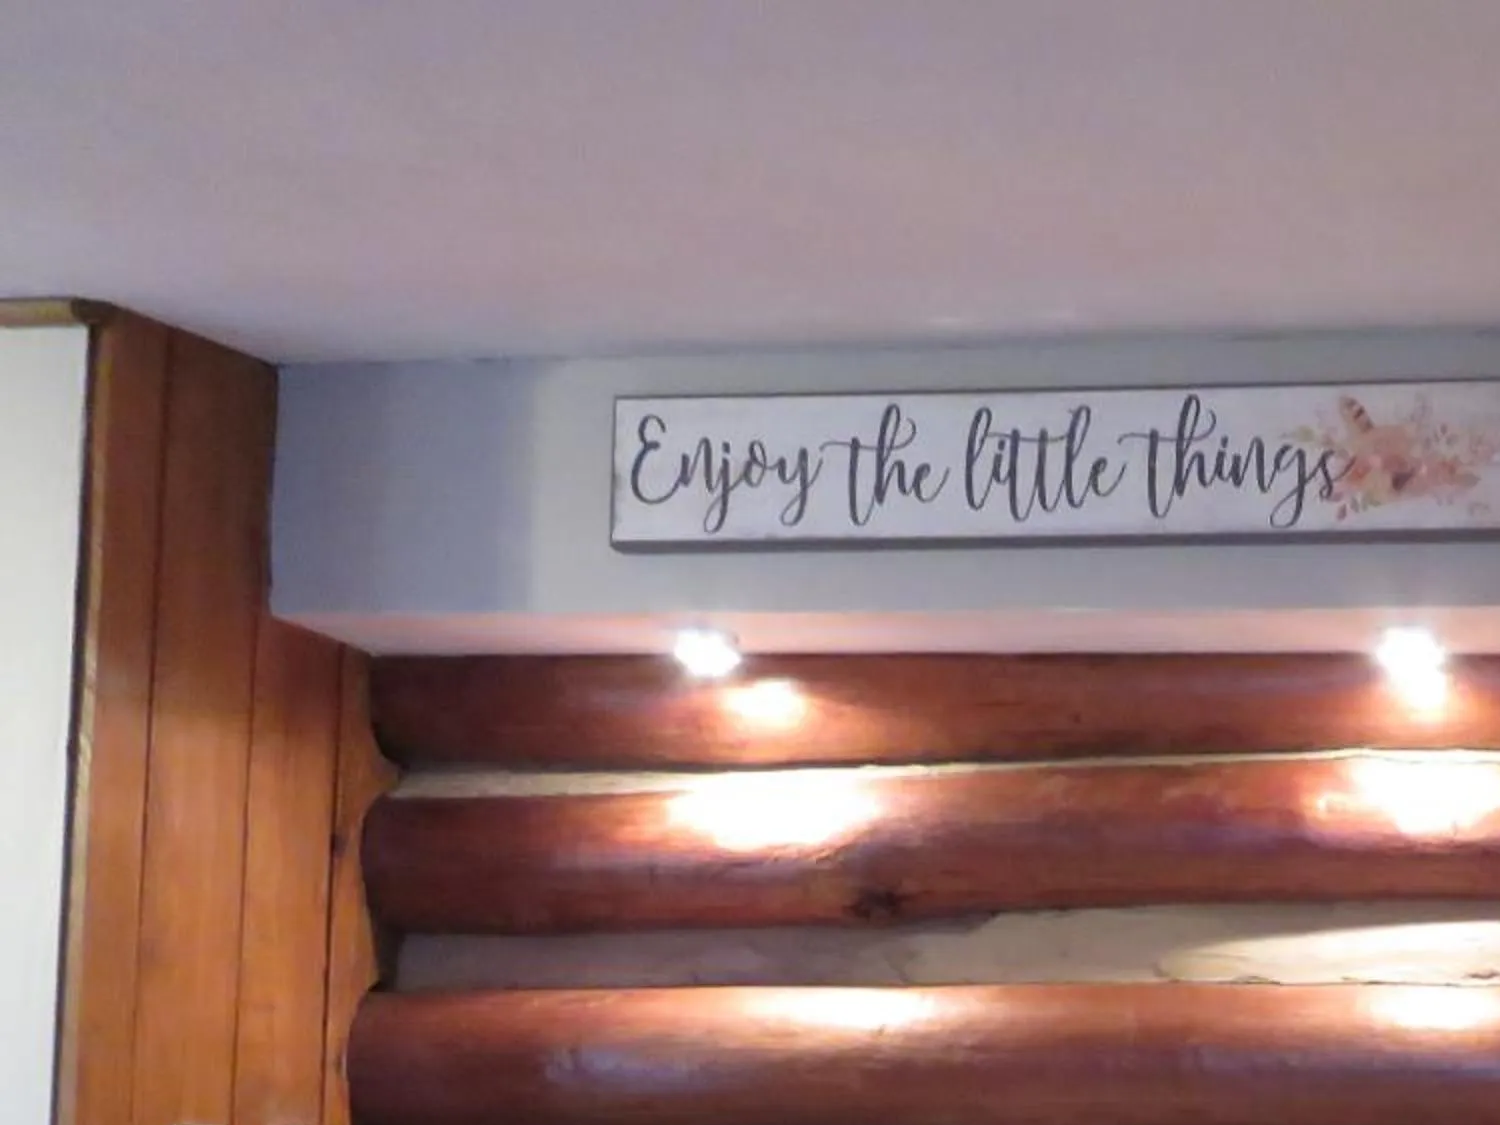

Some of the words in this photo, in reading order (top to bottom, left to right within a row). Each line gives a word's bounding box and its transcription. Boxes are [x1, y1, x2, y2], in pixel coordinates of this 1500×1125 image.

[631, 414, 824, 534] Enjoy
[819, 403, 950, 526] the
[964, 405, 1127, 521] little
[1116, 393, 1357, 529] things
